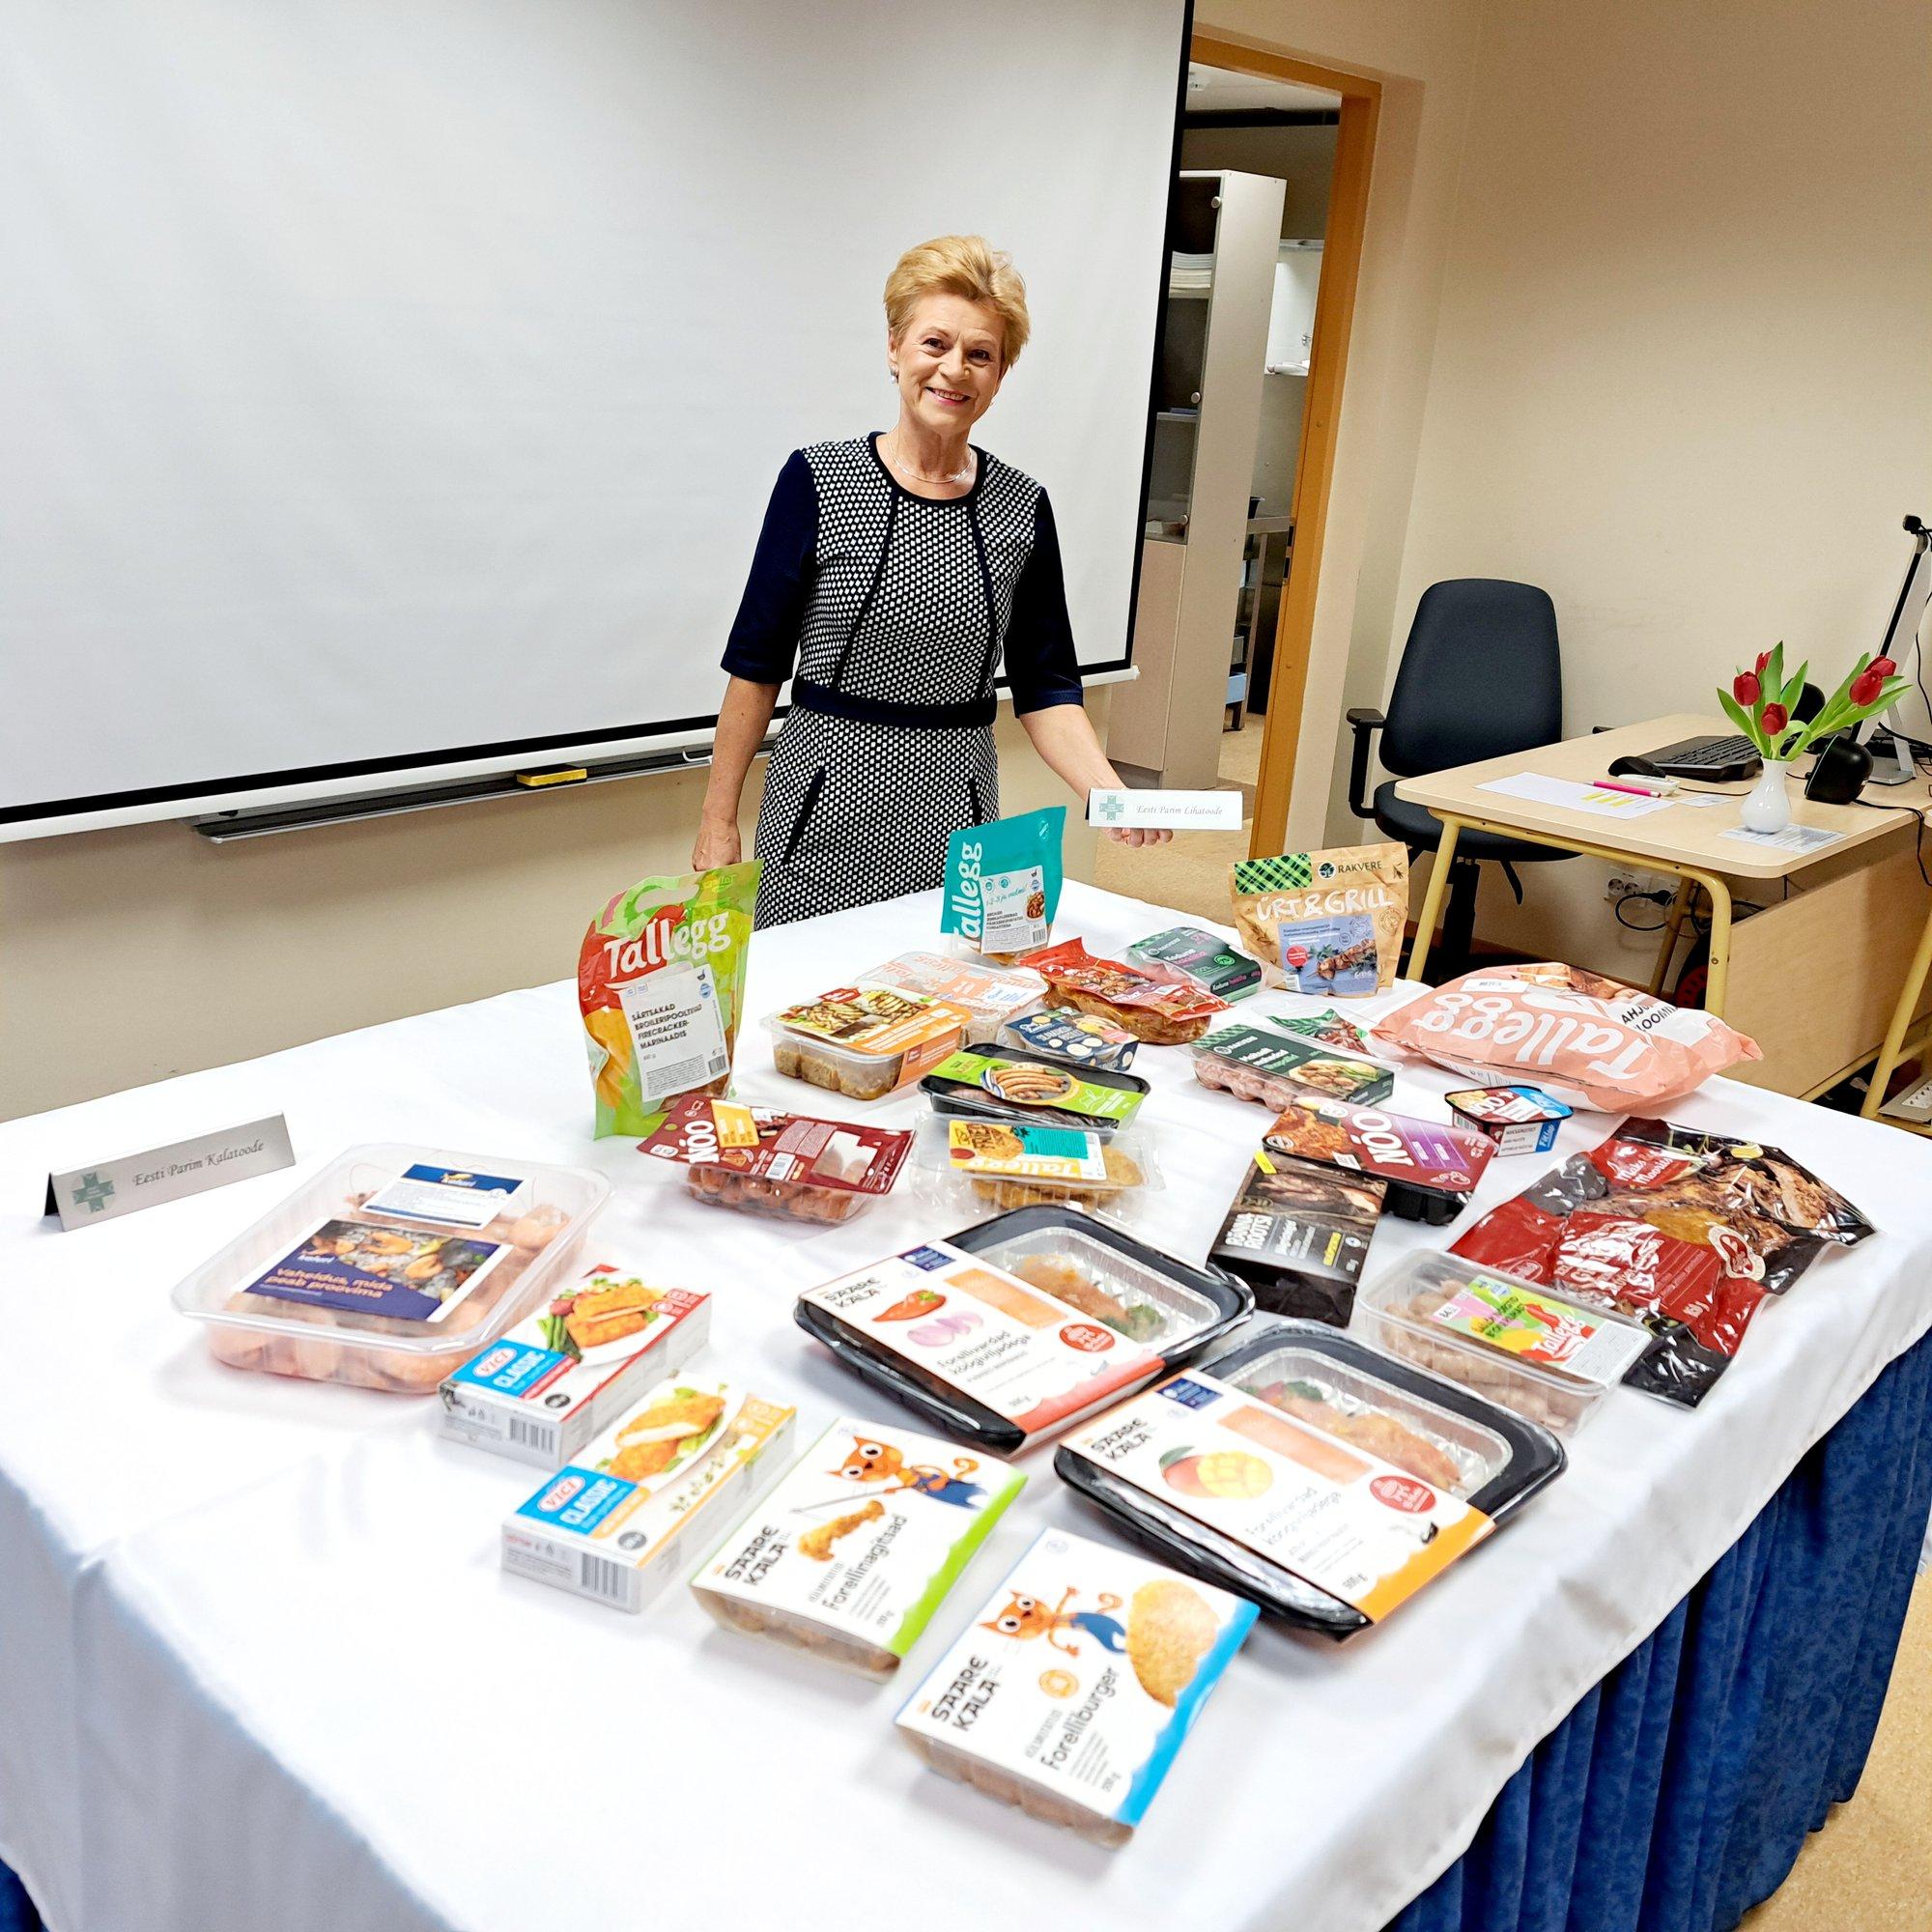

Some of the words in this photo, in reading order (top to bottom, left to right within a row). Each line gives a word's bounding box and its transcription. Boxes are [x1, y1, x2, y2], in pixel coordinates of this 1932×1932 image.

[1135, 804, 1156, 815] Eesti
[1158, 804, 1181, 815] Parim
[1184, 805, 1223, 816] Lihatoode
[1338, 860, 1382, 874] RAKVERE
[604, 912, 731, 980] Tallegg
[1411, 992, 1651, 1081] Tallegg
[679, 1120, 720, 1164] NÕO
[1350, 1112, 1416, 1167] NÕO
[132, 1166, 165, 1187] Eesti
[167, 1157, 203, 1179] Parim
[205, 1139, 264, 1167] Kalatoode
[823, 1276, 881, 1303] SAARE
[835, 1287, 884, 1309] KALA
[1531, 1314, 1586, 1352] Tallegg
[480, 1350, 511, 1374] VICI
[1090, 1416, 1149, 1453] SAARE
[1105, 1432, 1152, 1462] KALA
[546, 1481, 578, 1507] VICI
[724, 1523, 780, 1581] SAARE
[744, 1542, 789, 1587] KALA
[821, 1513, 908, 1611] Forellinagitsad
[931, 1653, 989, 1722] SAARE
[952, 1675, 1002, 1732] KALA
[1040, 1666, 1121, 1771] Forelliburger
